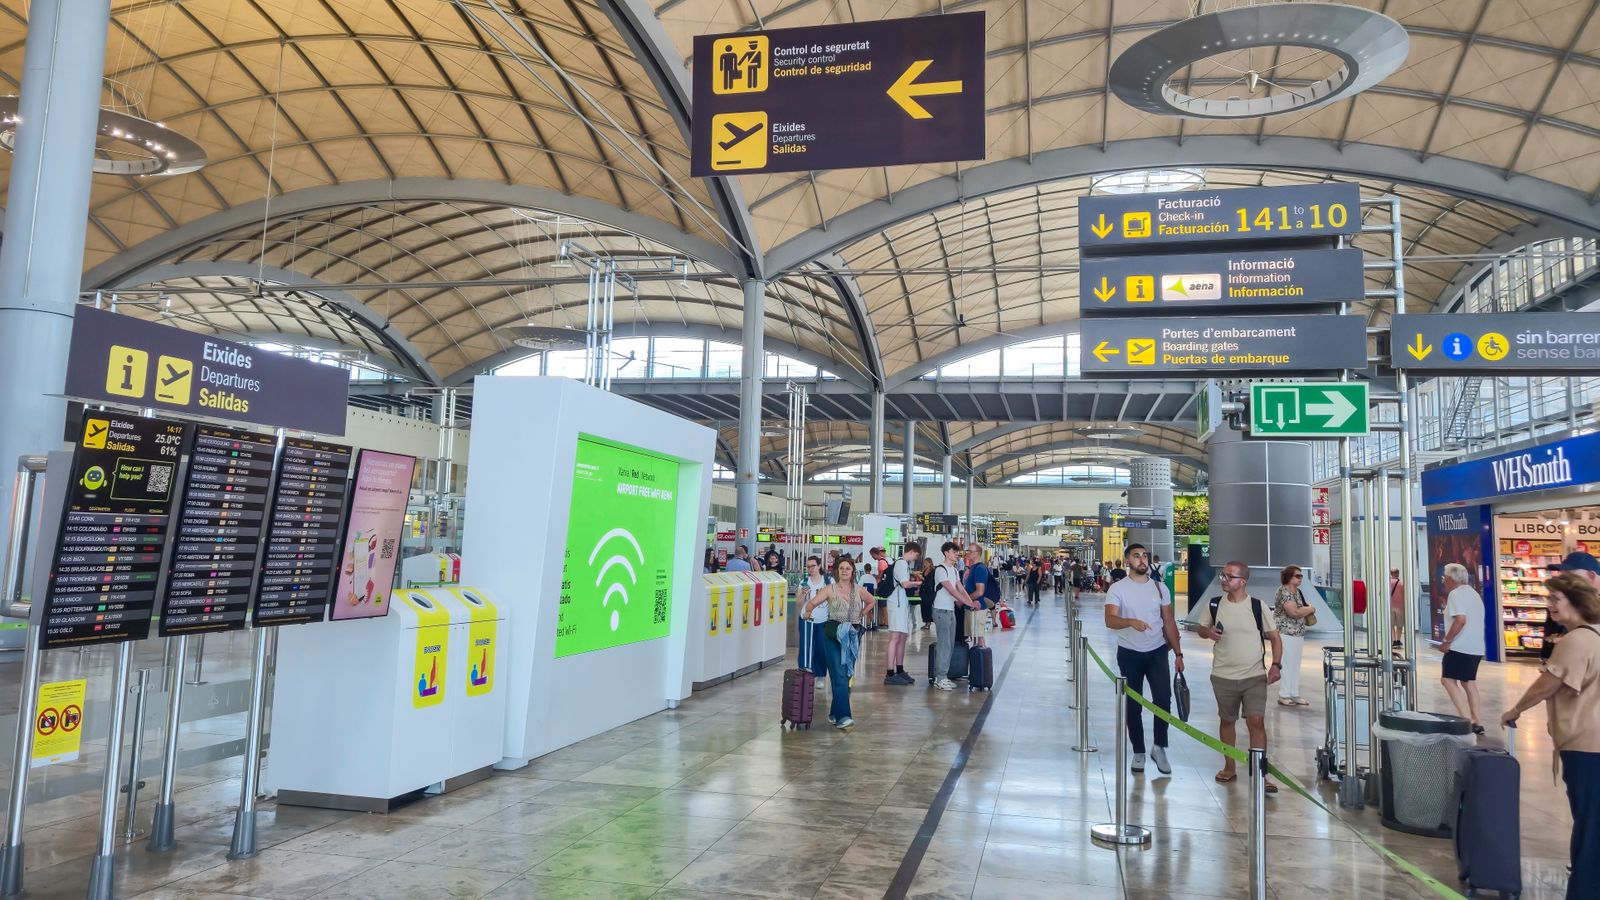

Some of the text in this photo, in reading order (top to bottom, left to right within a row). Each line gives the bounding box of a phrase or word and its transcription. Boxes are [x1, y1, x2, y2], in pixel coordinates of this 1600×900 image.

[774, 40, 870, 56] Control de seguretat
[774, 54, 835, 67] Security control
[774, 61, 871, 77] Control de seguridad
[773, 123, 805, 133] Eixides
[773, 133, 816, 144] Departures
[773, 144, 806, 154] Salidas
[1158, 196, 1221, 210] Facturació
[1159, 211, 1204, 222] Check-in
[1237, 203, 1347, 232] 141 to 10
[1159, 222, 1229, 235] Facturación
[1296, 220, 1303, 228] a
[1228, 257, 1295, 270] Informació
[1228, 272, 1291, 283] Information
[1189, 282, 1214, 291] aena
[1229, 285, 1304, 298] Información
[1163, 328, 1199, 339] Portes
[1516, 330, 1542, 344] sin
[1163, 341, 1239, 352] Boarding gates
[203, 341, 252, 369] Eixides
[1163, 353, 1289, 366] Puertas de embarque
[1517, 348, 1570, 359] sense
[200, 366, 260, 392] Departures
[198, 388, 249, 413] Salidas
[111, 420, 134, 430] Eixides
[108, 431, 142, 441] Departures
[106, 441, 135, 452] Salidas
[160, 446, 177, 456] 61%
[1492, 446, 1572, 492] WHSmith
[119, 472, 130, 480] help
[617, 482, 638, 496] AIRPORT
[639, 486, 650, 498] FREE
[1438, 512, 1468, 531] WHSmith
[1514, 523, 1600, 534] LIBROS BO
